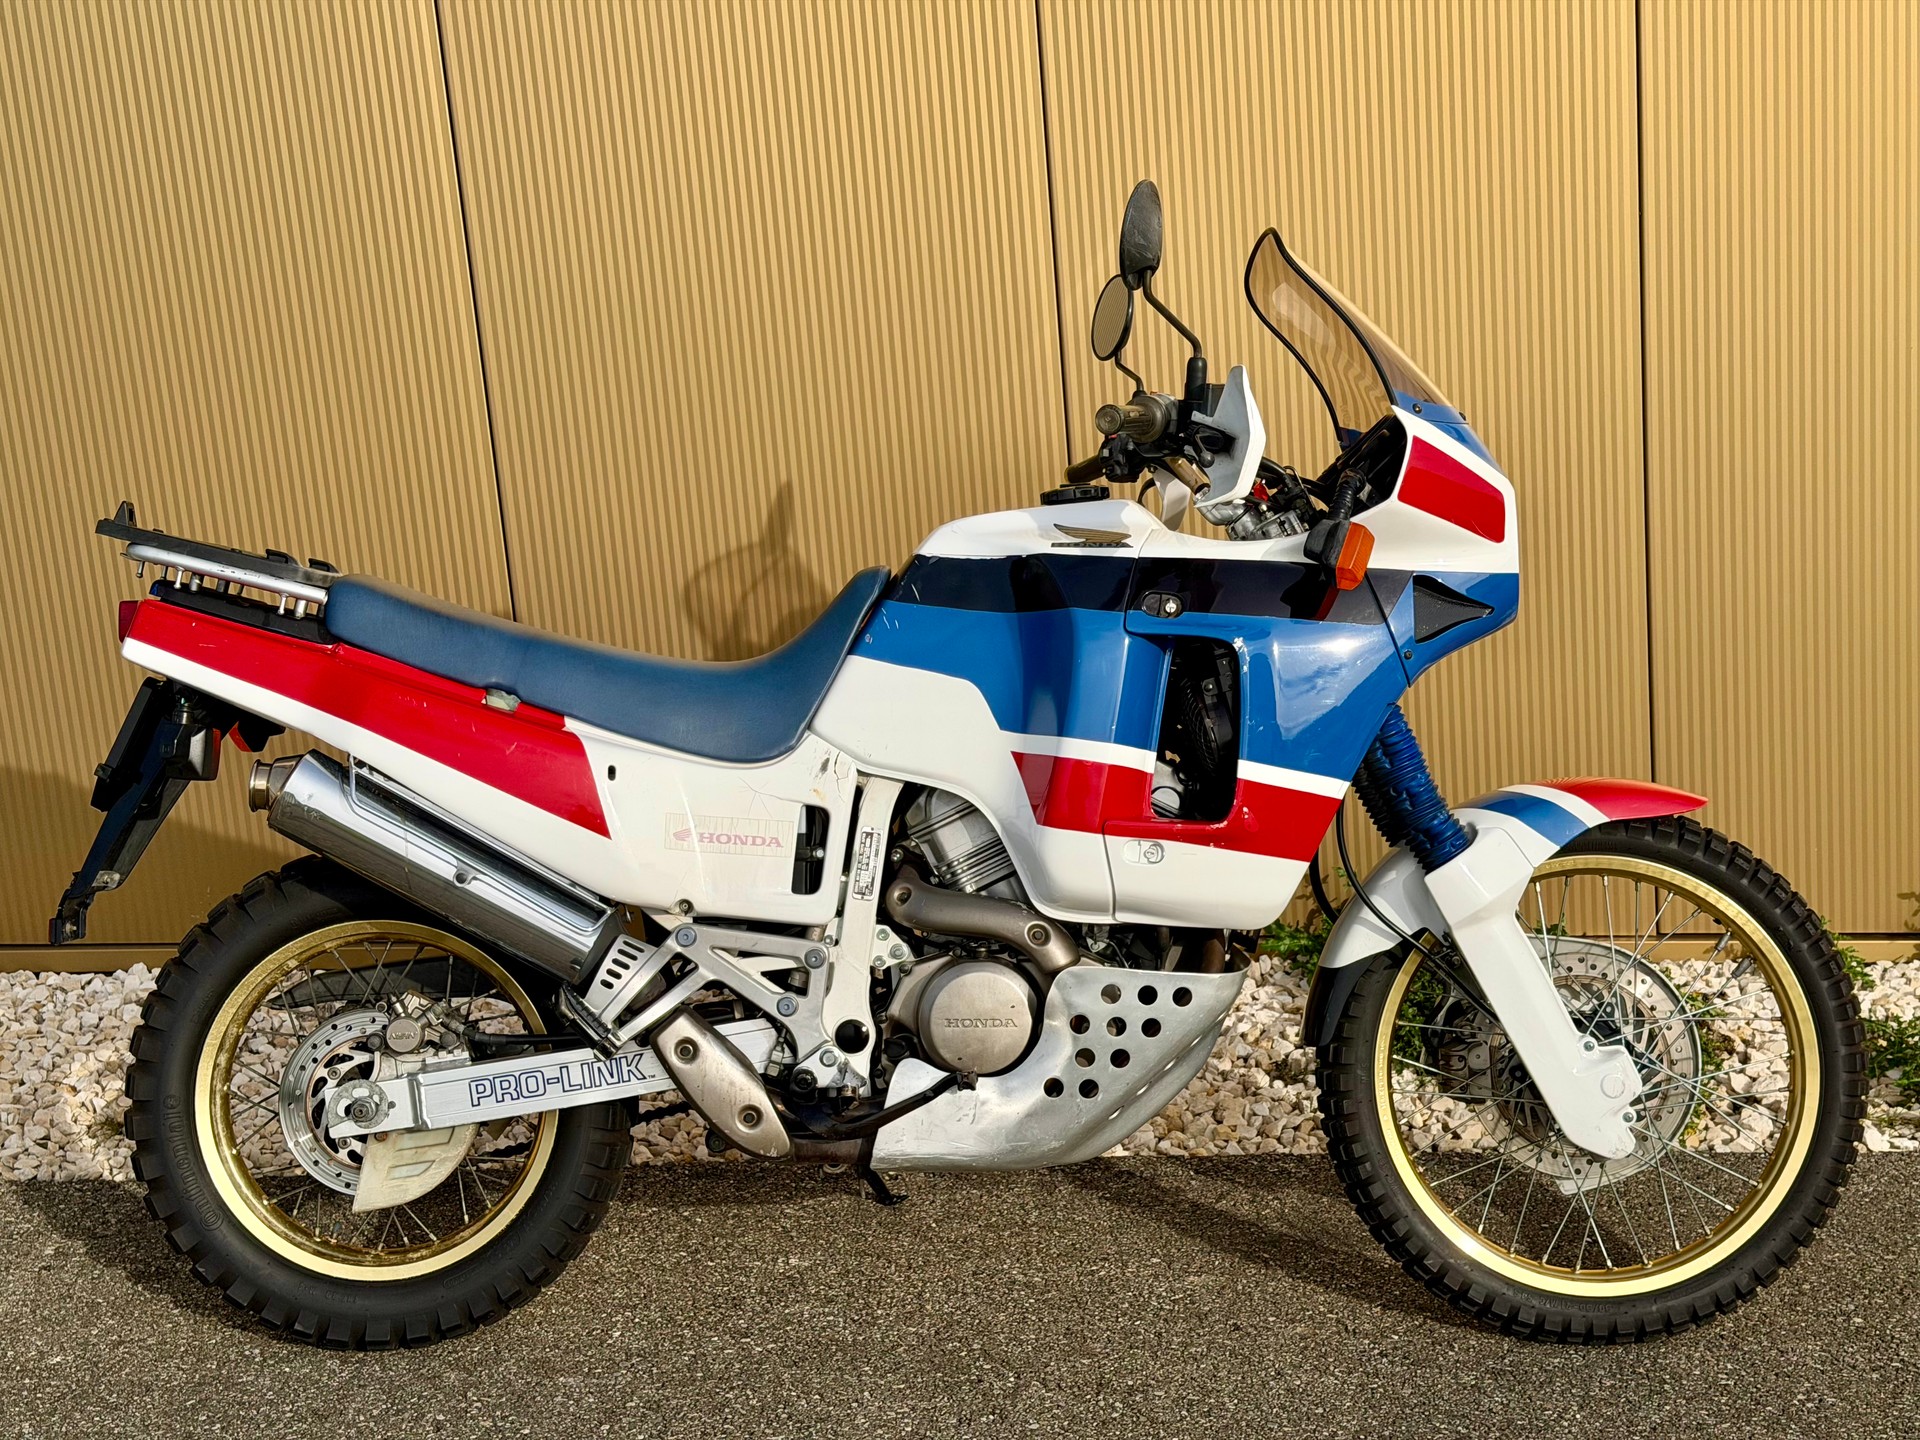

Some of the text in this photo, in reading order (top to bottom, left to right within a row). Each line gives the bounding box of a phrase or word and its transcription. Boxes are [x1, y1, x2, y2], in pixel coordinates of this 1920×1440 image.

[698, 831, 784, 849] HONDA
[943, 1018, 1018, 1028] HONDA
[469, 1053, 646, 1107] PRO-LINK
[163, 1109, 226, 1233] Continental
